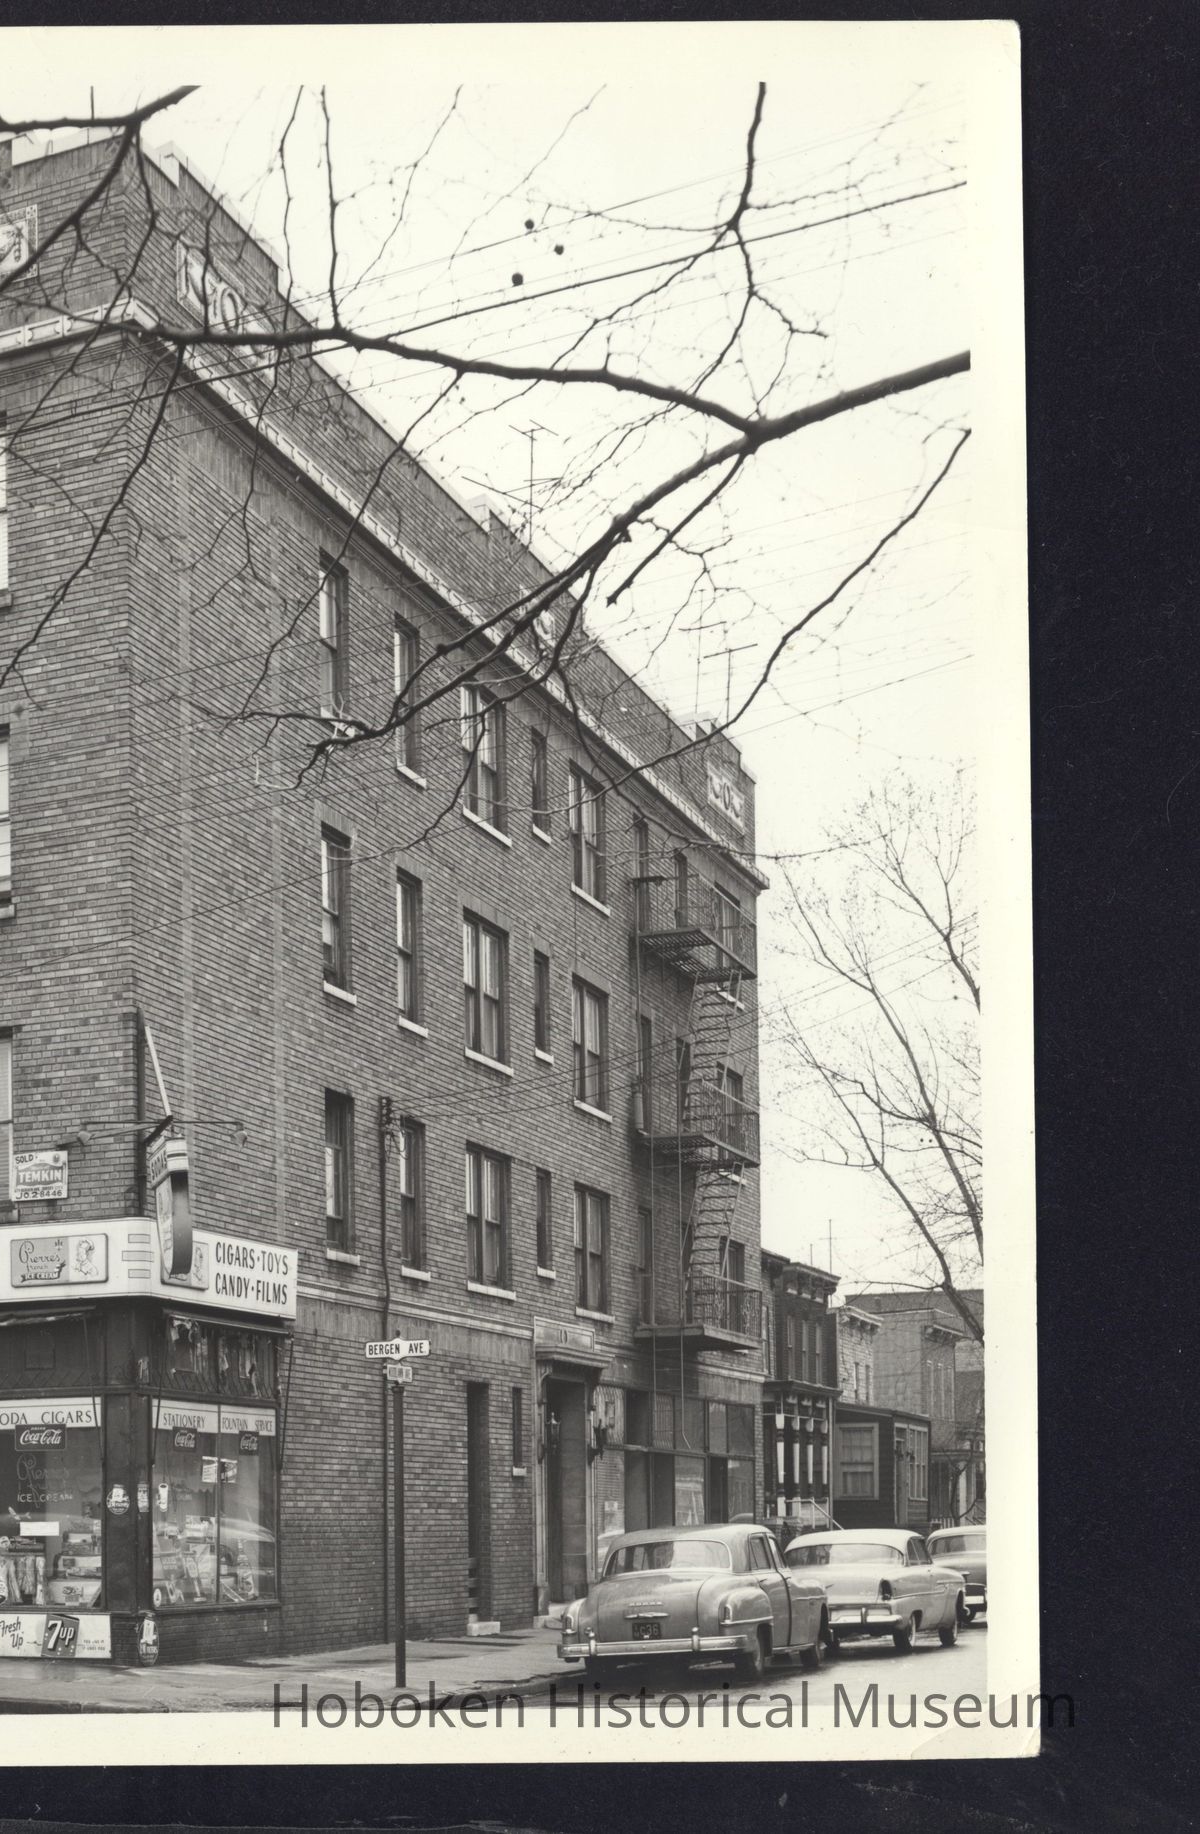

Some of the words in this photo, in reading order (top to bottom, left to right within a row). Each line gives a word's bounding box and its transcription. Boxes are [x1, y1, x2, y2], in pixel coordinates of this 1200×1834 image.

[15, 1154, 34, 1165] SOLD
[18, 1169, 62, 1183] TEMKIN
[368, 1343, 400, 1355] BERGEN
[41, 1410, 92, 1425] CIGARS
[163, 1413, 206, 1429] STATIONERY
[221, 1417, 248, 1431] FOUNTAIN
[254, 1420, 273, 1433] SERVICE
[17, 1493, 33, 1503] ICE
